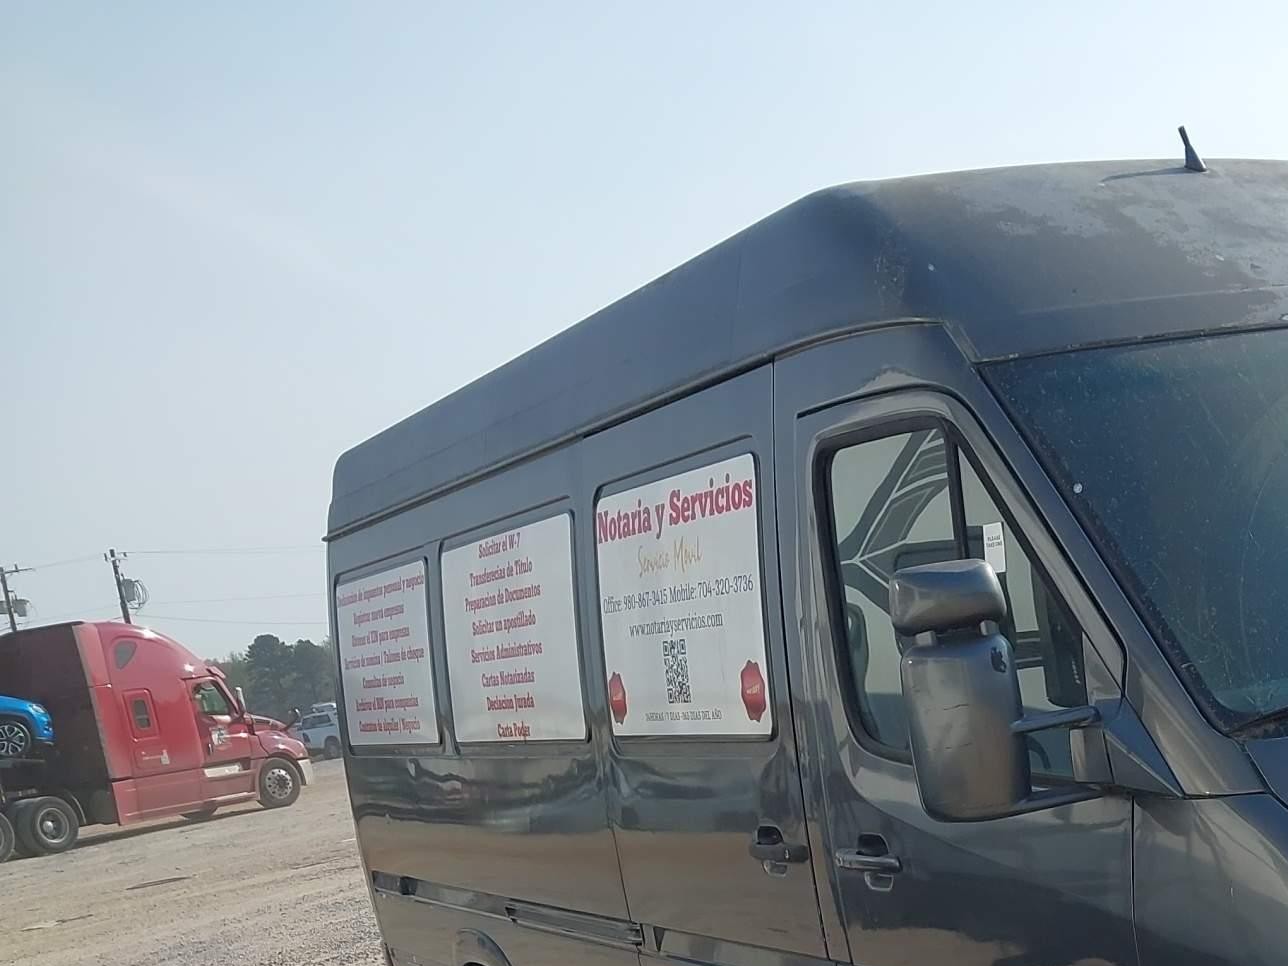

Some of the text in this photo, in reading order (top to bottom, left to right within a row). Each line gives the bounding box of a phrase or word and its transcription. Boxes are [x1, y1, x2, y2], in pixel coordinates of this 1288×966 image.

[598, 473, 753, 544] Notaria y Servicios
[479, 532, 520, 559] Solicitar el W-7
[507, 561, 513, 577] de
[497, 588, 504, 605] de
[505, 584, 541, 603] Documentos
[624, 588, 667, 611] 980-867-3415
[669, 582, 697, 604] Mobile:
[698, 573, 753, 599] 704-320-3736
[504, 609, 536, 633] apostillado
[471, 640, 543, 663] Servicios Administrativos
[482, 667, 535, 687] Cartas Notarizadas
[514, 692, 535, 712] Jurada
[498, 723, 513, 738] Carta
